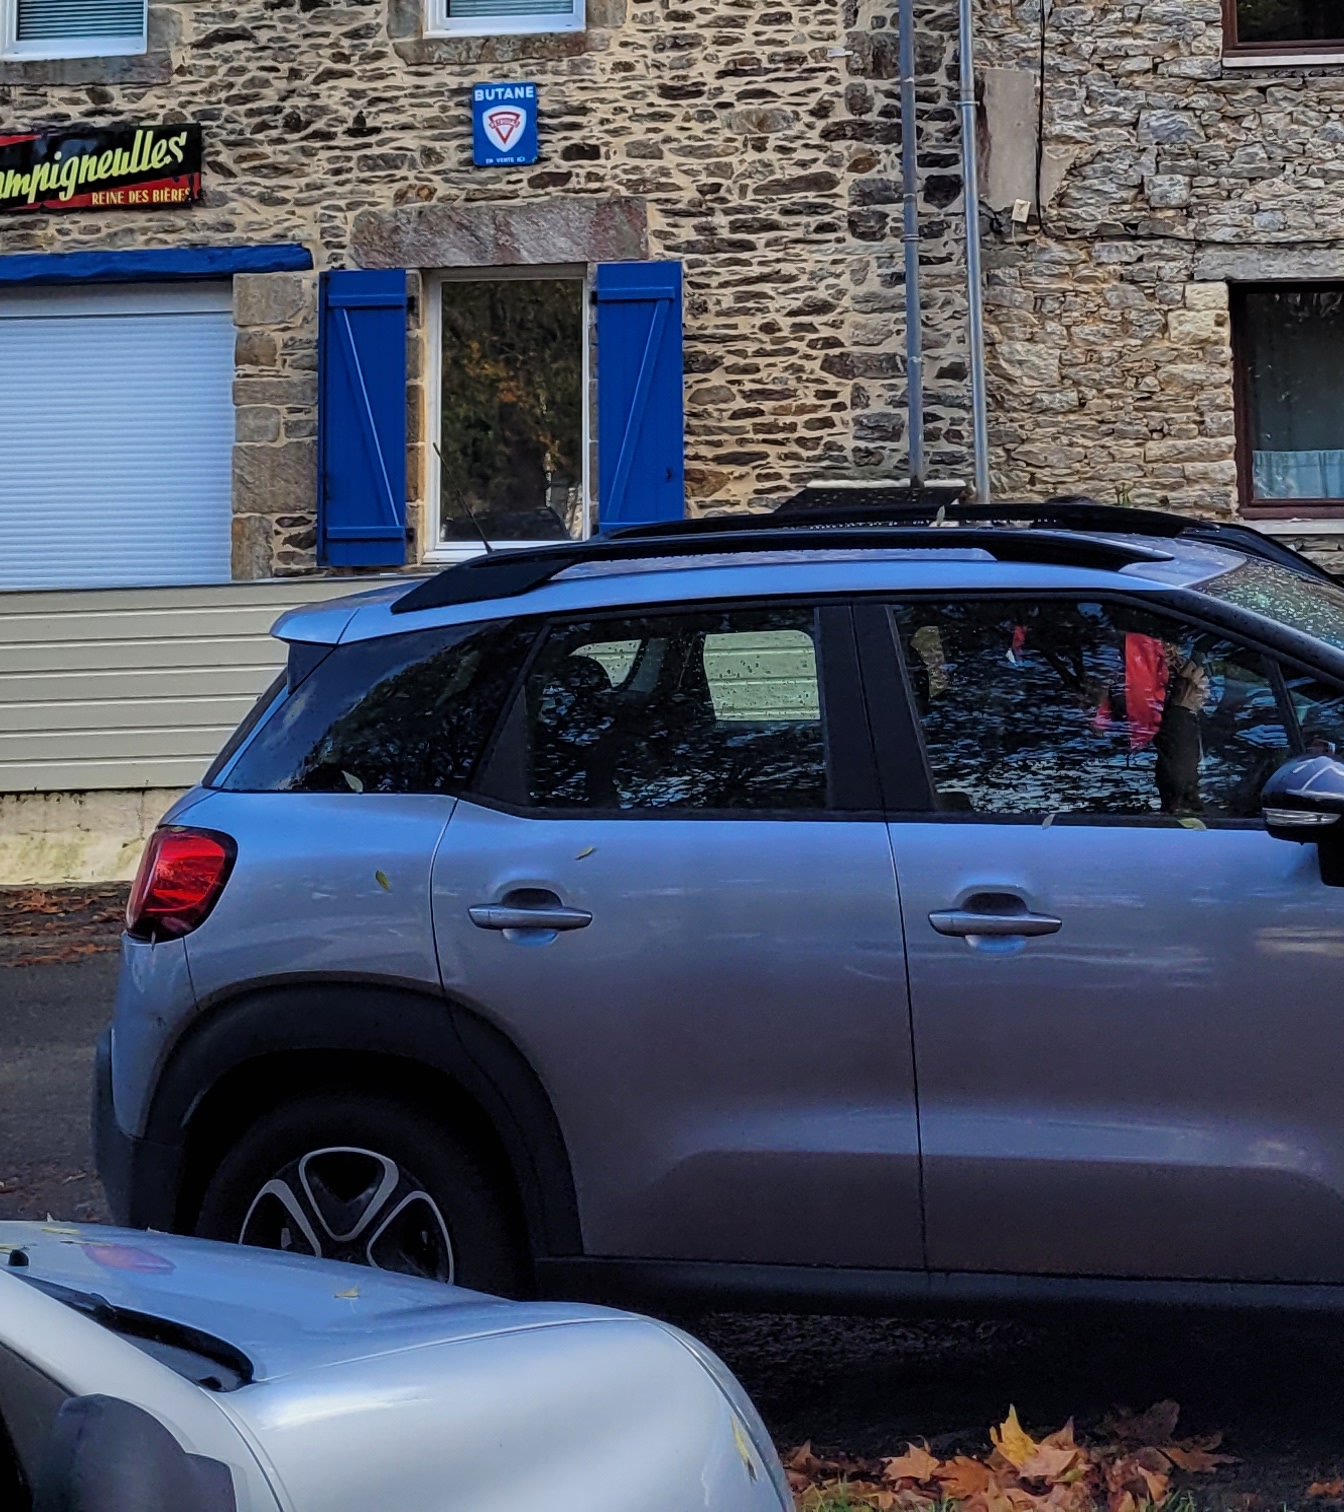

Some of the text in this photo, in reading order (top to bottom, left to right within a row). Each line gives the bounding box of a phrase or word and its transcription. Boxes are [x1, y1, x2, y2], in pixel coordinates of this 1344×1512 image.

[474, 86, 534, 102] BUTANE
[91, 191, 125, 205] REINE
[128, 189, 149, 204] DES
